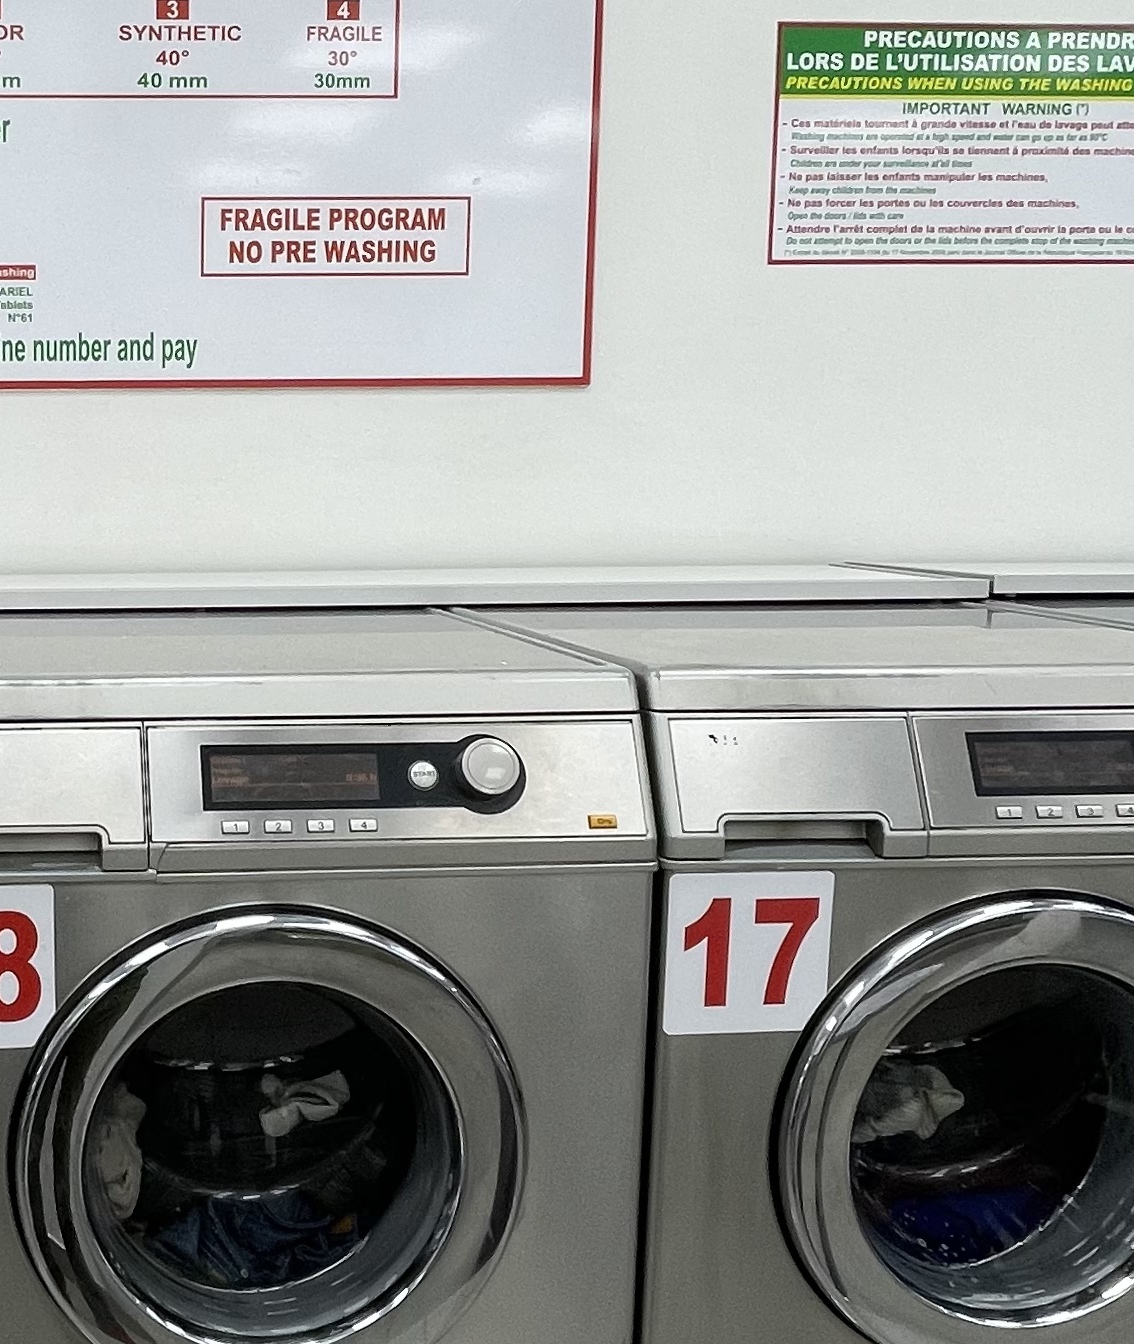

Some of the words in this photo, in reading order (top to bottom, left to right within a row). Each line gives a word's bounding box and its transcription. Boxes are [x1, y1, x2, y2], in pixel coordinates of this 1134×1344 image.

[166, 0, 179, 19] 3
[336, 0, 351, 19] 4
[118, 24, 242, 42] SYNTHETIC
[306, 25, 383, 42] FRAGILE
[864, 30, 1020, 50] PRECAUTIONS
[1025, 30, 1042, 49] A
[786, 52, 844, 72] LORS
[850, 51, 880, 72] DE
[885, 52, 1042, 73] L'UTILISATION
[1048, 53, 1090, 73] DES
[137, 72, 162, 88] 40
[169, 76, 208, 89] mm
[314, 73, 371, 89] 30mm
[785, 75, 904, 91] PRECAUTIONS
[907, 75, 958, 90] WHEN
[961, 77, 1014, 92] USING
[1019, 76, 1052, 93] THE
[1056, 76, 1134, 92] WASHING
[902, 101, 992, 116] IMPORTANT
[1001, 101, 1073, 116] WARNING
[221, 209, 320, 231] FRAGILE
[330, 208, 445, 230] PROGRAM
[229, 241, 262, 263] NO
[272, 241, 316, 263] PRE
[324, 240, 435, 263] WASHING
[34, 332, 111, 361] number
[118, 332, 153, 361] and
[162, 340, 197, 368] pay
[684, 898, 819, 1004] 17
